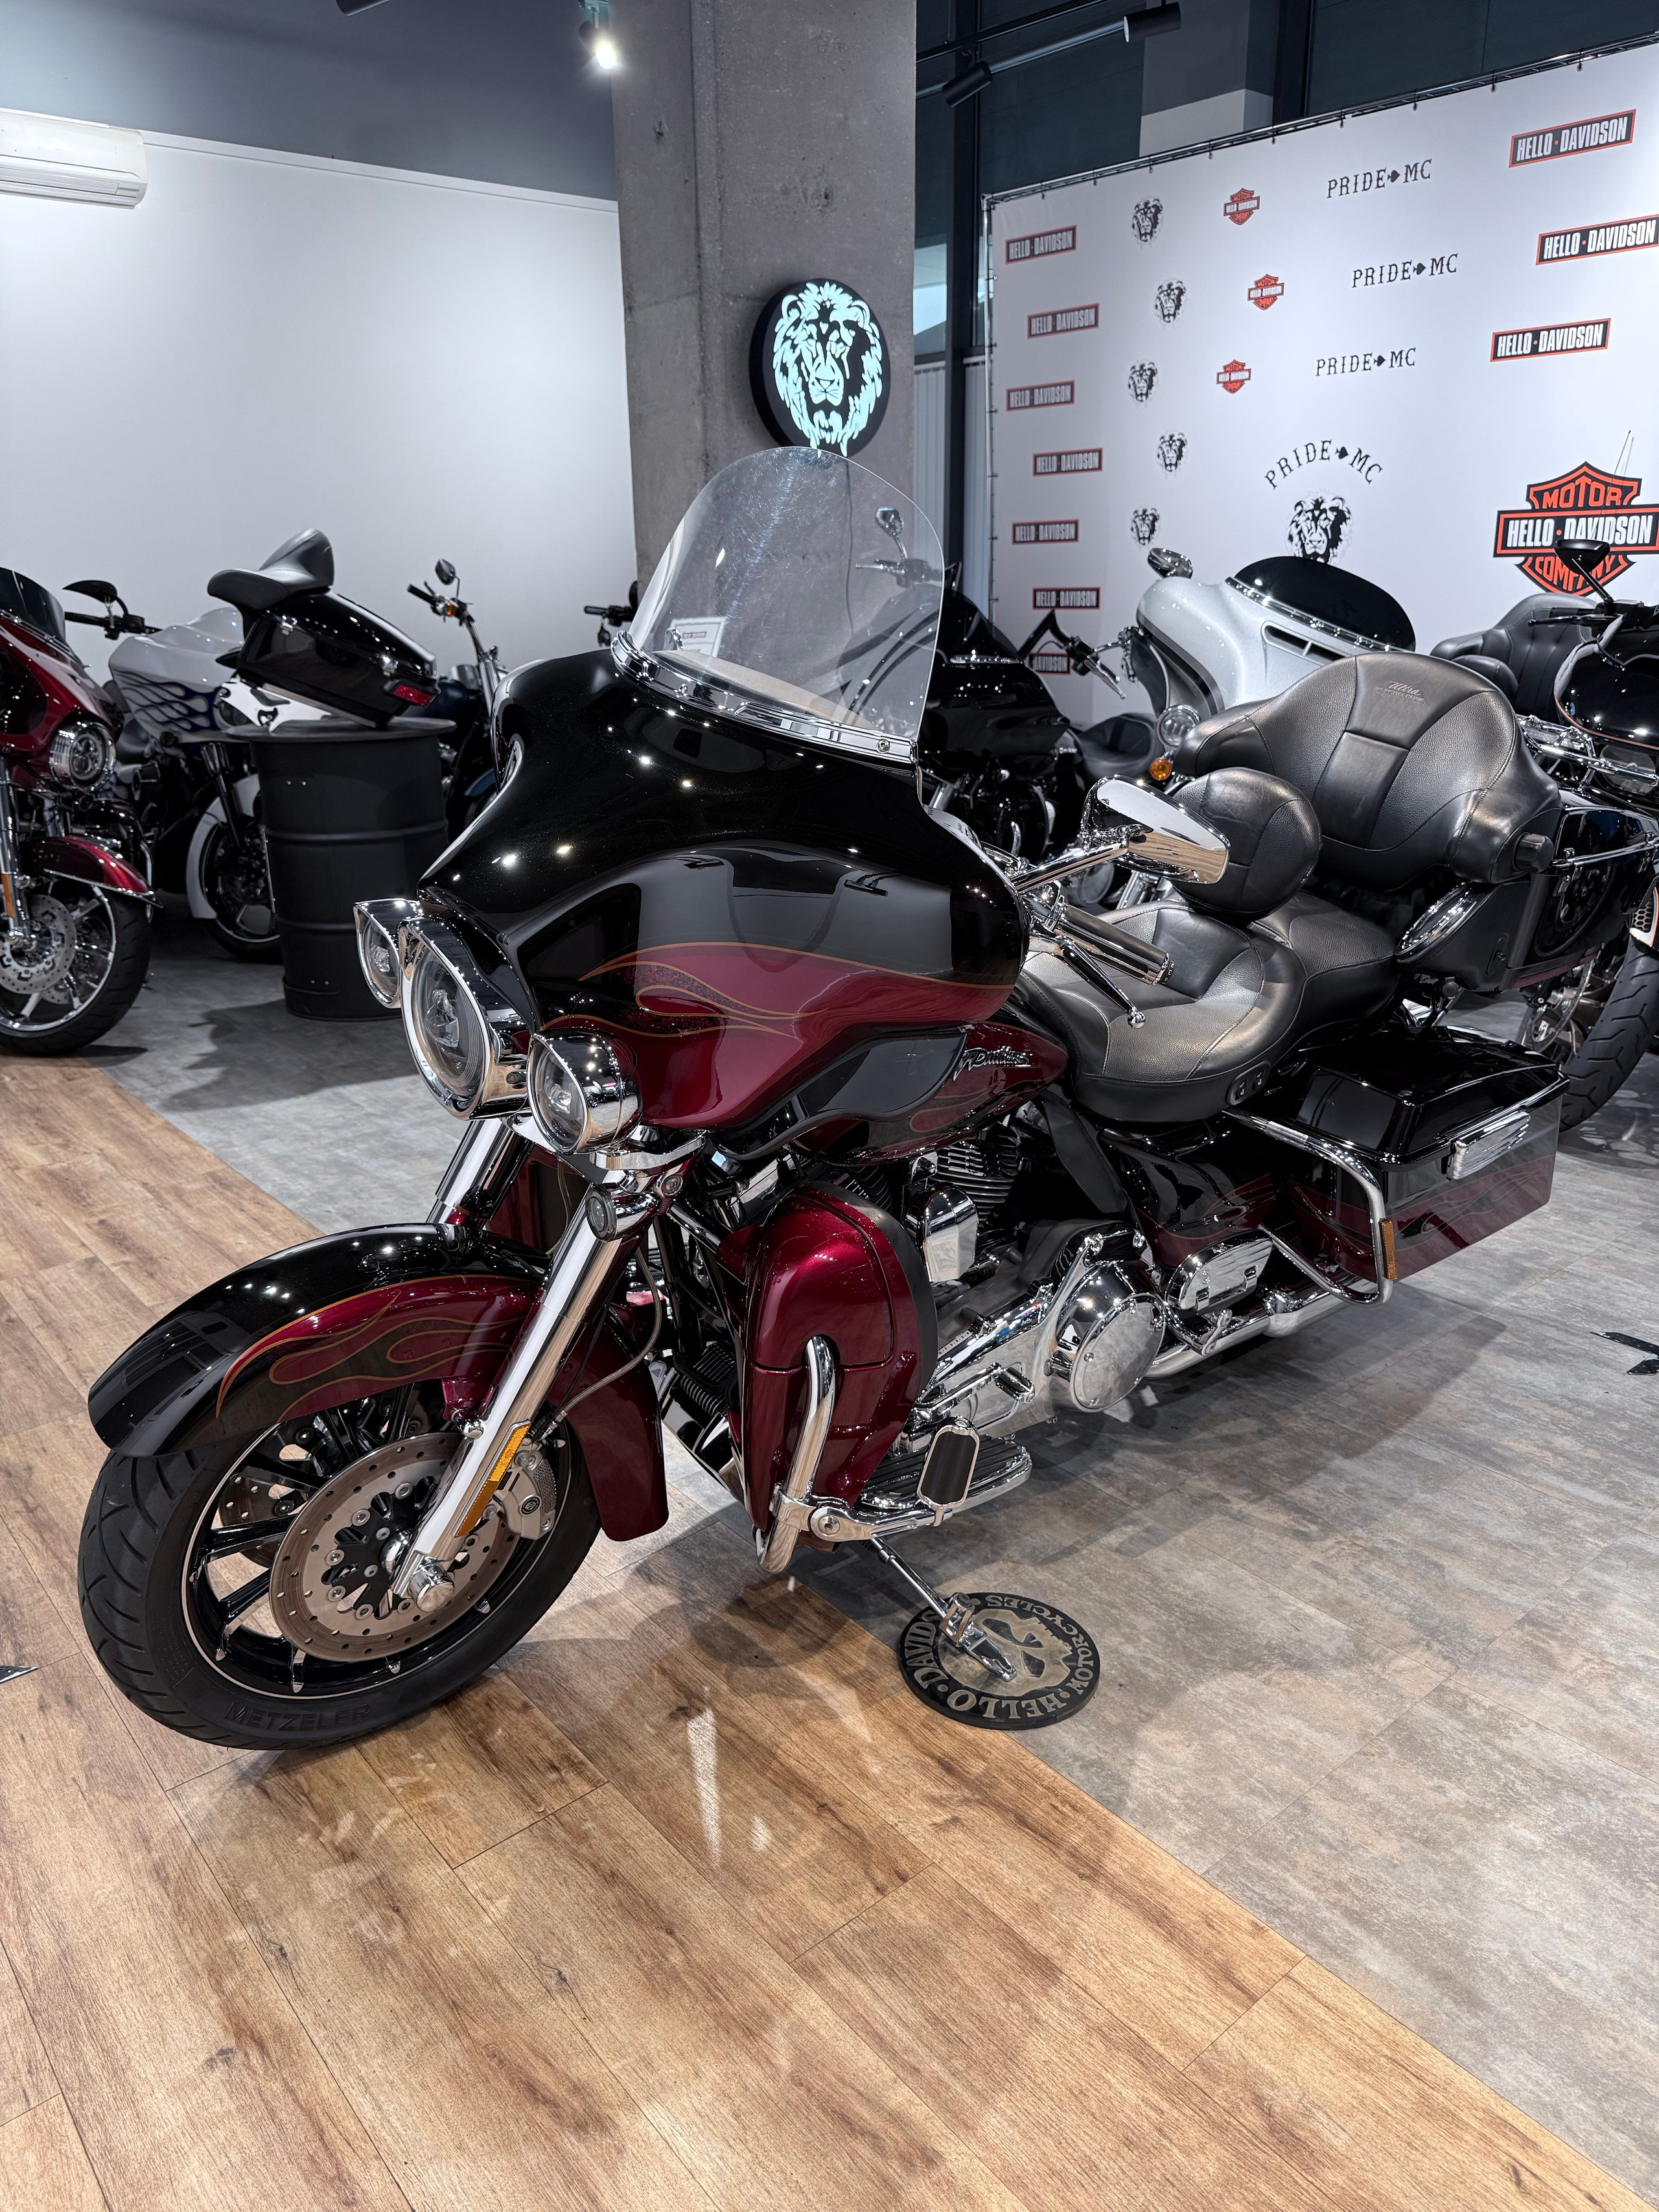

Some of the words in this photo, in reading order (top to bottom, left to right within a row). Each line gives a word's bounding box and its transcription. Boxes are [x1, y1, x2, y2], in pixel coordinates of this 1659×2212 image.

[1516, 133, 1553, 161] HELLO
[1560, 117, 1627, 152] DAVIDSON
[1327, 167, 1386, 199] PRIDE
[1403, 158, 1432, 183] MC
[1009, 239, 1030, 260] HELLO
[1034, 229, 1073, 255] DAVIDSON
[1544, 233, 1581, 259] HELLO
[1587, 220, 1656, 252] DAVIDSON
[1351, 260, 1413, 288] PRIDE
[1428, 253, 1458, 277] MC
[1031, 315, 1052, 335] HELLO
[1056, 307, 1095, 331] DAVIDSON
[1497, 332, 1531, 357] HELLO
[1538, 323, 1603, 352] DAVIDSON
[1316, 352, 1373, 377] PRIDE
[1389, 347, 1416, 368] MC
[1010, 390, 1030, 408] HELLO
[1034, 384, 1071, 405] DAVIDSON
[1036, 455, 1057, 473] HELLO
[1061, 452, 1099, 471] DAVIDSON
[1264, 439, 1332, 490] PRIDE
[1349, 447, 1383, 484] MC
[1542, 475, 1622, 509] MOTOR
[1015, 526, 1036, 541] HELLO
[1039, 523, 1076, 541] DAVIDSON
[1507, 518, 1555, 547] HELLO
[1564, 515, 1653, 544] DAVIDSON
[1036, 590, 1056, 607] HELLO
[1060, 590, 1097, 607] DAVIDSON
[1388, 681, 1421, 696] Ultra
[985, 1595, 1094, 1695] MOTORCYCLES
[224, 1701, 370, 1731] METZELER
[947, 1690, 1067, 1719] HELLO
